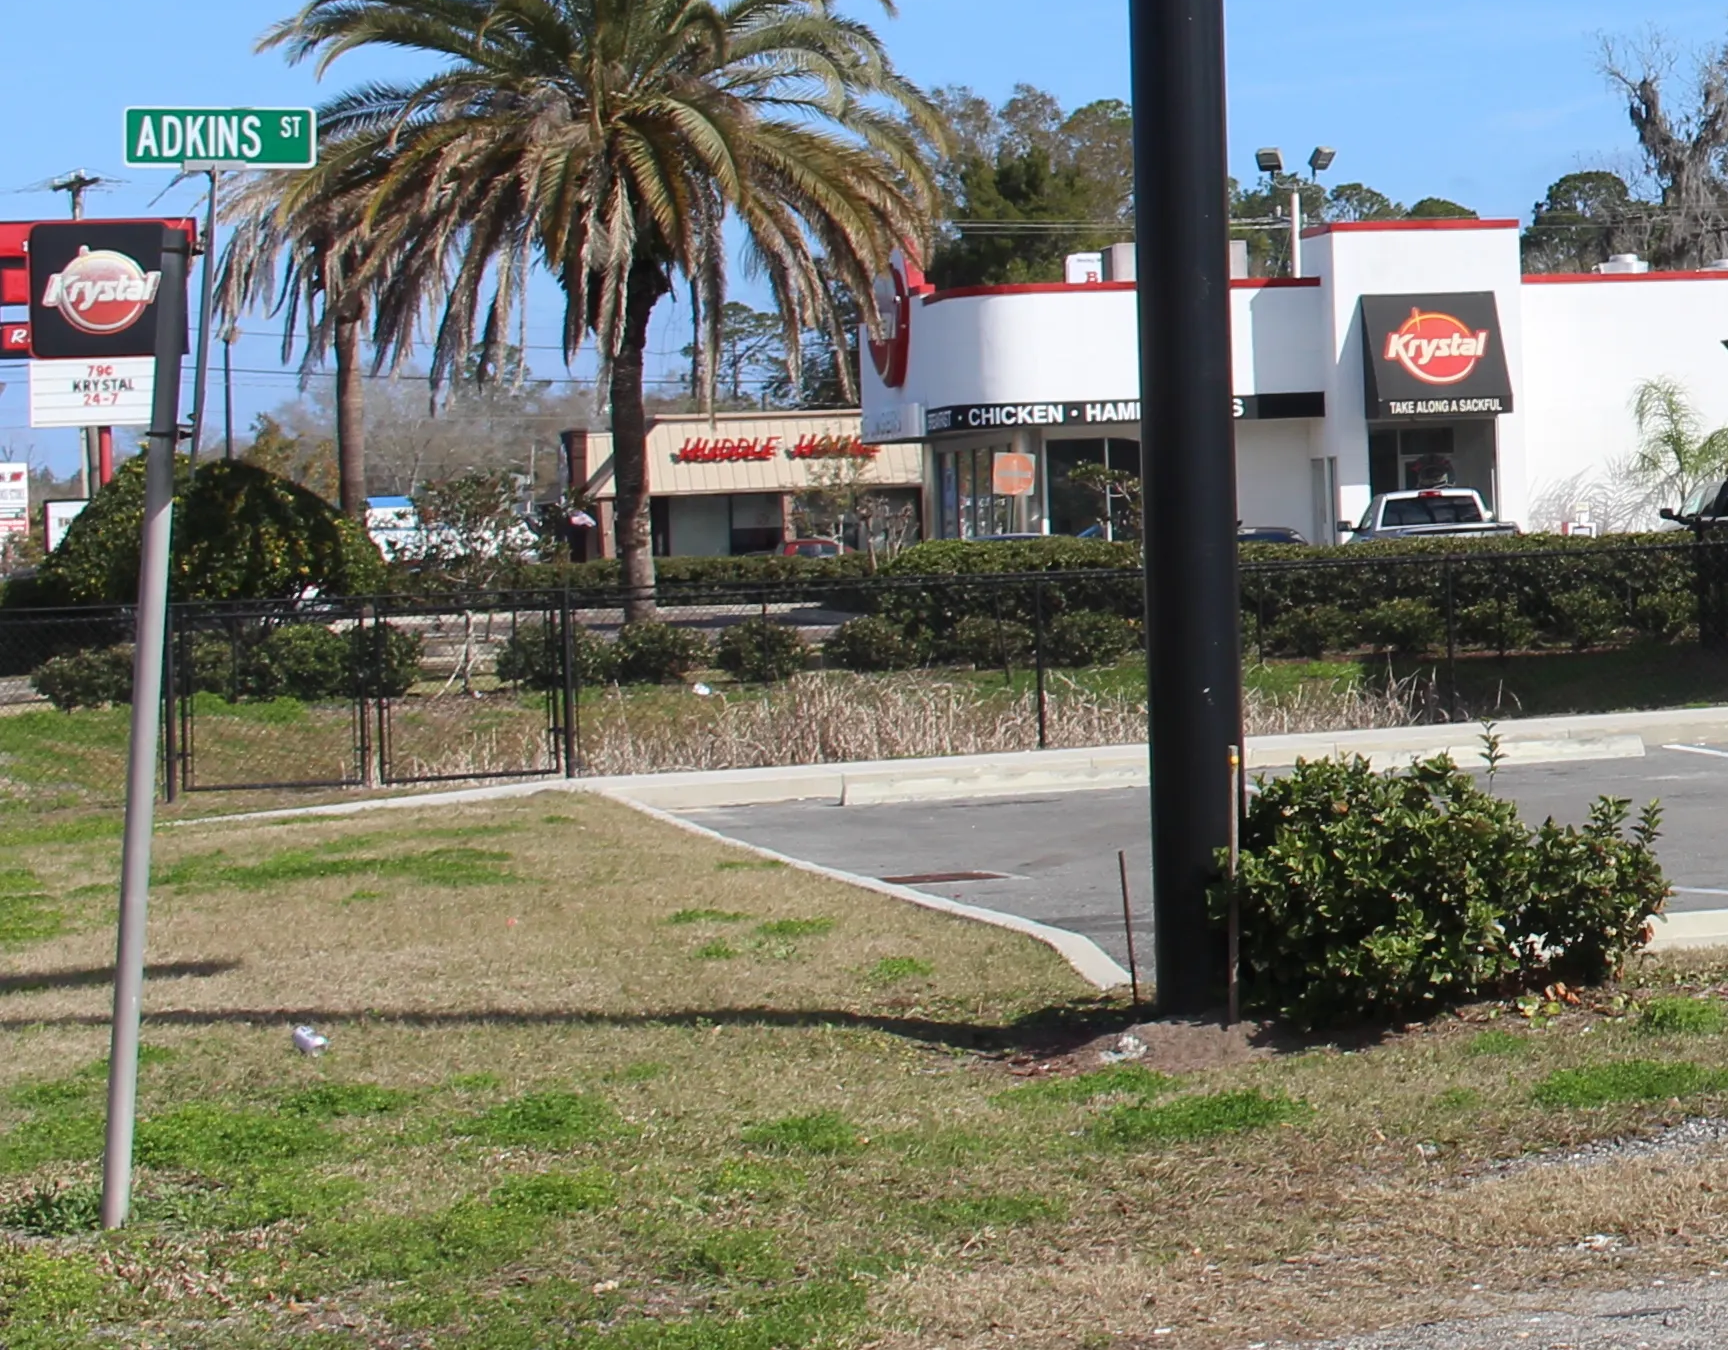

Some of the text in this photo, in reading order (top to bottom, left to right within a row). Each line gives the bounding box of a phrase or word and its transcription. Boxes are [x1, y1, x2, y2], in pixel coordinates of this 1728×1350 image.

[136, 115, 302, 158] ADKINS ST
[43, 271, 161, 311] Krystal
[1386, 331, 1488, 365] Krystal
[72, 378, 135, 391] KRYSTAL
[83, 393, 119, 406] 24-7
[1389, 398, 1502, 414] TAKE ALONG A SACKFUL
[968, 405, 1063, 425] CHICKEN
[679, 436, 782, 462] HUDDLE
